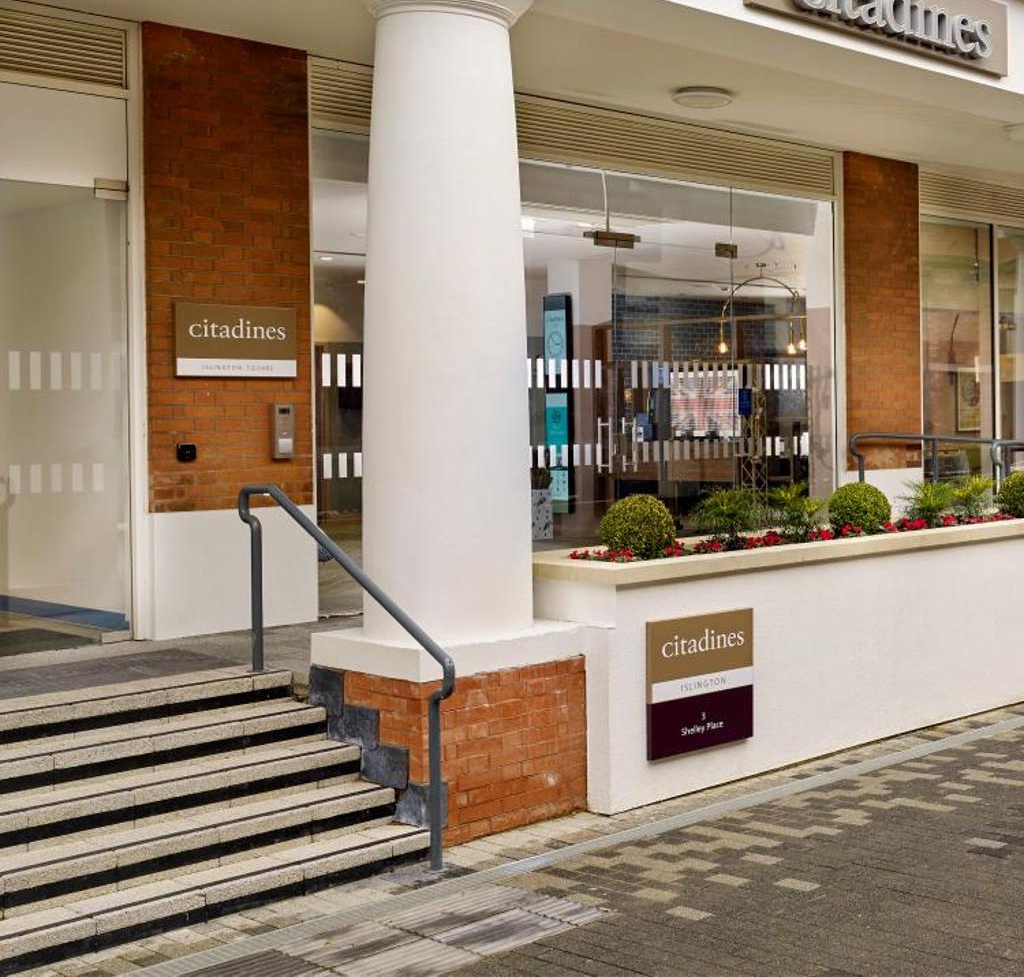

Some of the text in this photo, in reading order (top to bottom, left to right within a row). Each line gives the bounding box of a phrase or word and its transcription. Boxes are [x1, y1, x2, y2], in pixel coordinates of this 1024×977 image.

[188, 318, 286, 340] citadines
[661, 628, 745, 659] citadines
[680, 677, 727, 693] ISLINGTON
[706, 720, 725, 730] Place
